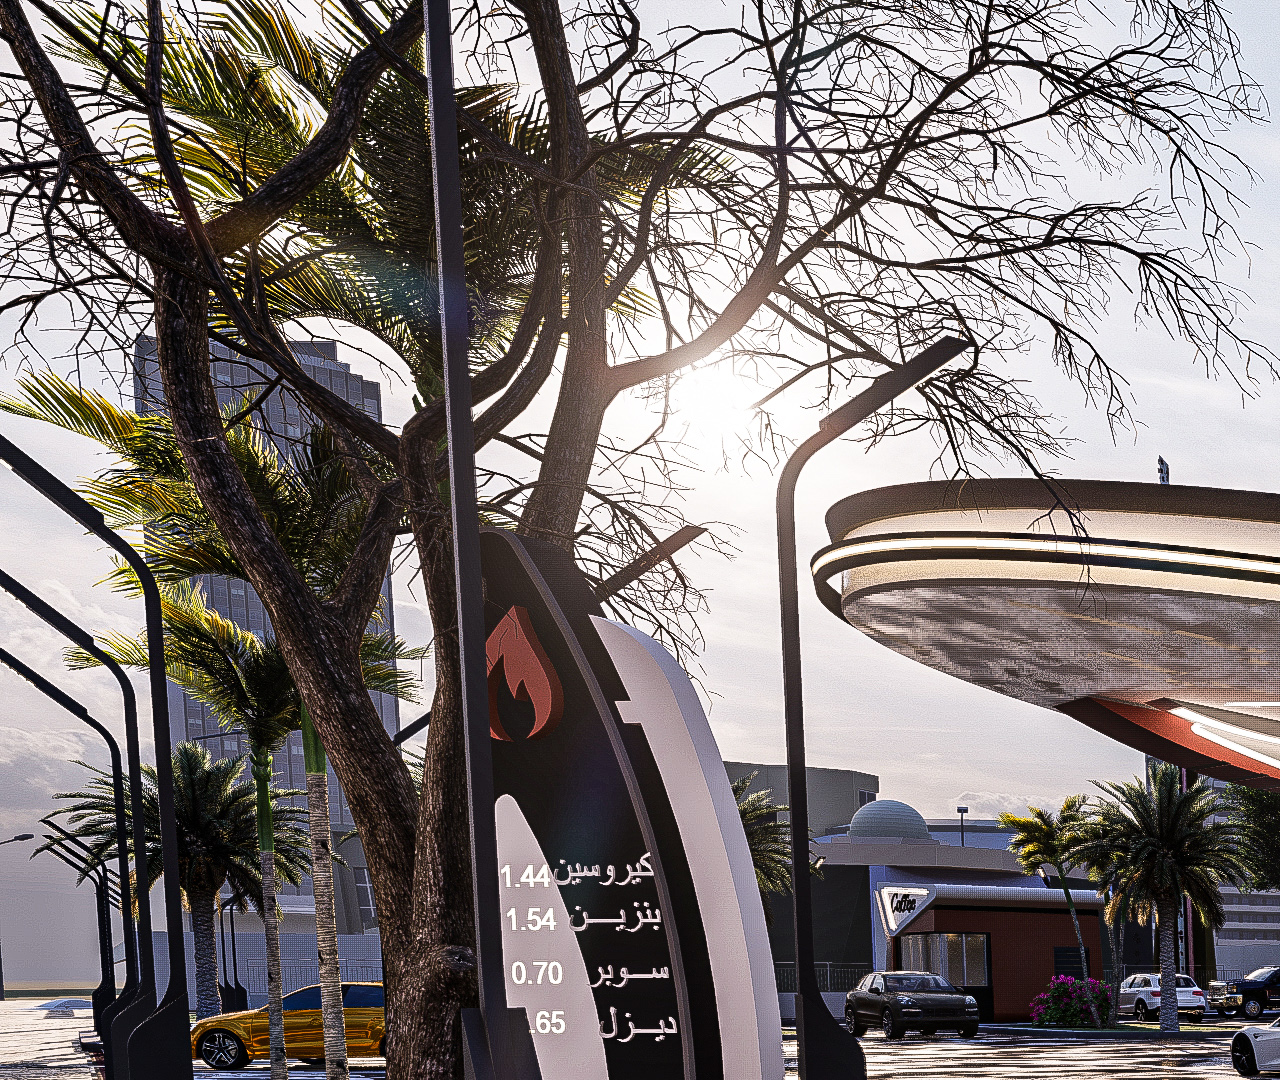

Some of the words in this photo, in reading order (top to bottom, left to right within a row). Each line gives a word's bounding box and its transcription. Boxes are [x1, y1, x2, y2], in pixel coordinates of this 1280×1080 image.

[500, 864, 551, 888] 1.44
[554, 851, 655, 886] كيروسين
[891, 892, 917, 914] Coffee
[506, 907, 557, 931] 1.54
[568, 901, 662, 932] بنزين
[511, 960, 563, 985] 0.70
[586, 964, 670, 988] سوبر
[529, 1010, 566, 1034] .65
[600, 1006, 678, 1042] ديزل
